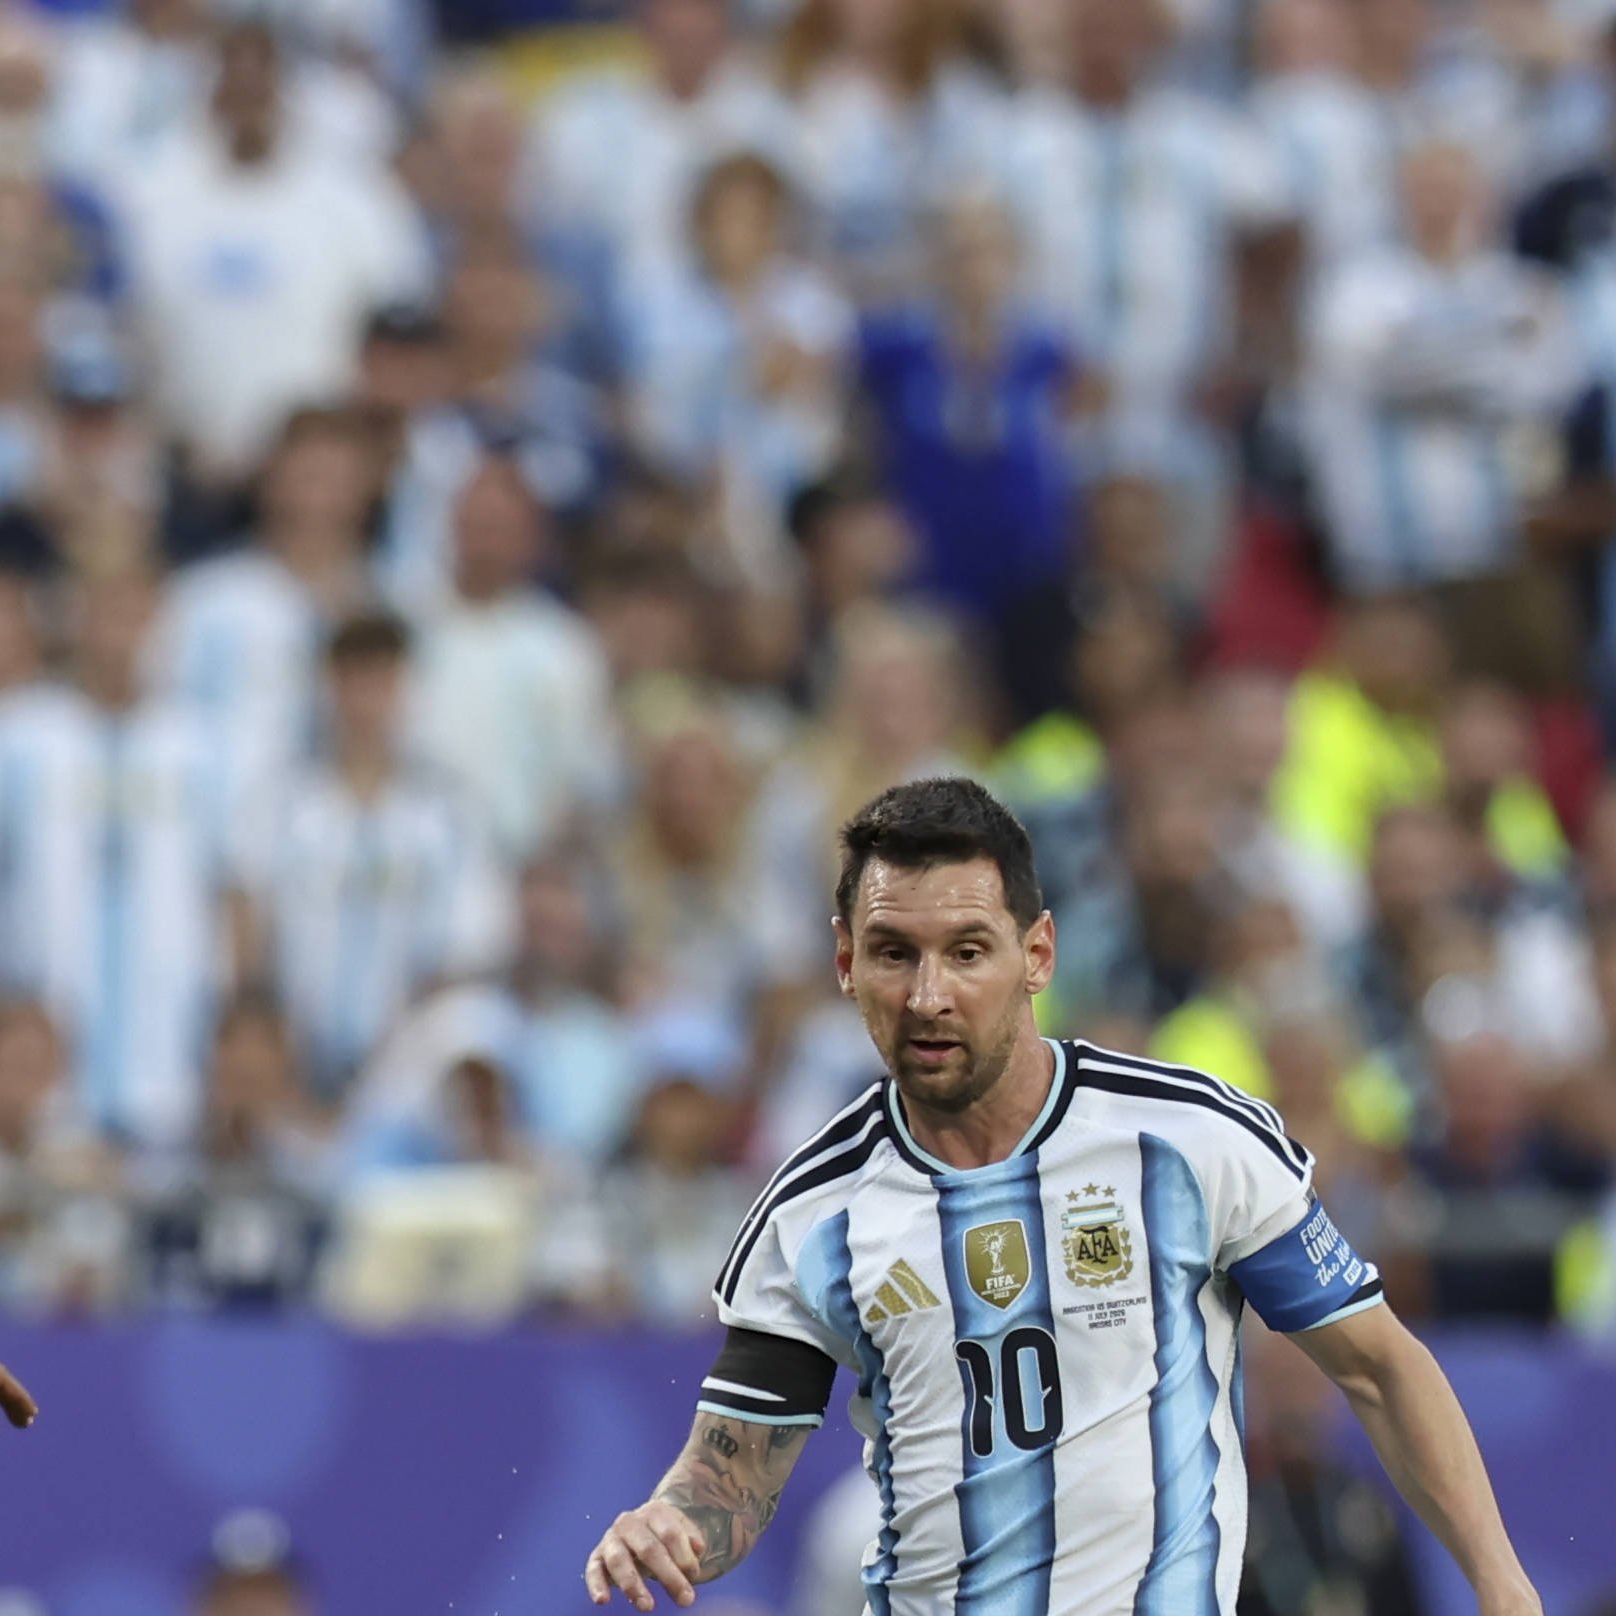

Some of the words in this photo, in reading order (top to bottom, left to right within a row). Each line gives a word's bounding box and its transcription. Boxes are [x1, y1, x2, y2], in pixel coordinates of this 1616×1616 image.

[1077, 1226, 1119, 1264] AFA
[986, 1274, 1015, 1290] FIFA
[954, 1326, 1063, 1458] 10
